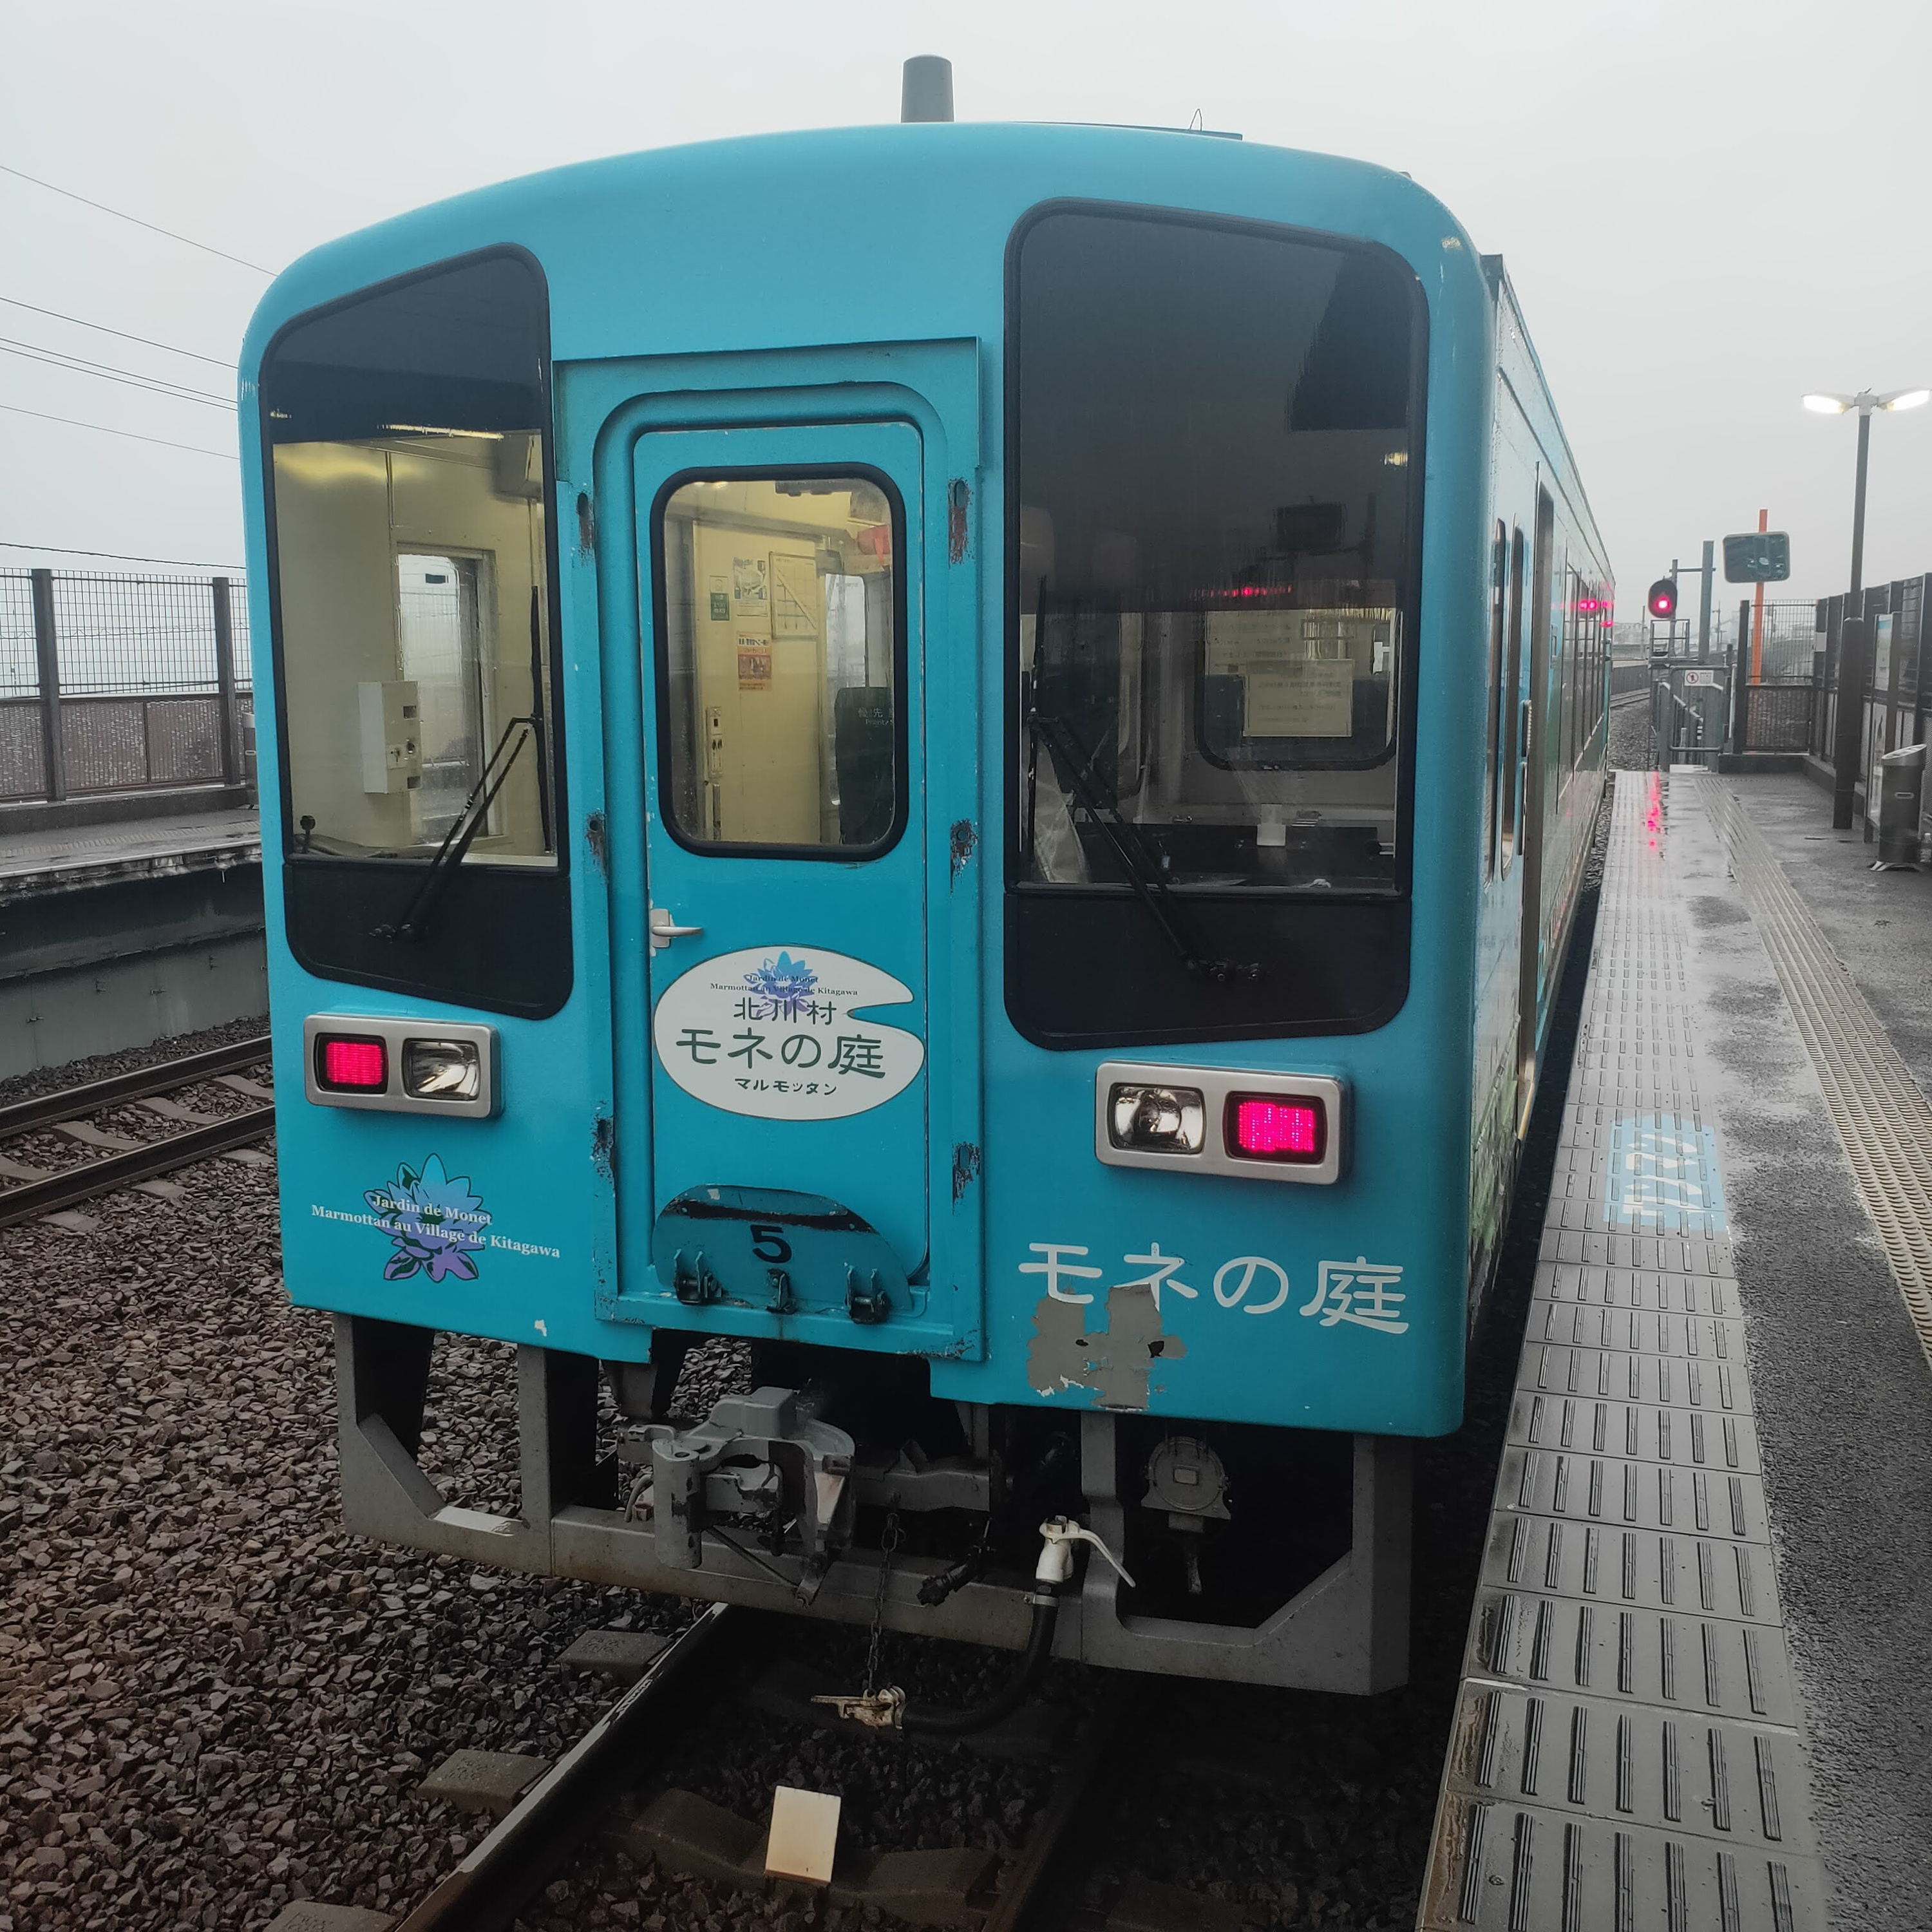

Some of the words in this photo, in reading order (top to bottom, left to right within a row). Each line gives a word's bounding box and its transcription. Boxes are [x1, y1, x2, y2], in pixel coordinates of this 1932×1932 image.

[817, 987, 858, 996] Kitagawa
[734, 997, 837, 1025] 北川村
[676, 1027, 886, 1079] モネの庭
[734, 1078, 837, 1095] マルモッタン
[373, 1196, 421, 1214] Jardin
[424, 1202, 442, 1217] de
[444, 1206, 493, 1226] Monet
[312, 1204, 390, 1229] Marmottan
[393, 1220, 412, 1233] au
[415, 1222, 465, 1242] Village
[468, 1230, 487, 1245] de
[490, 1235, 560, 1259] Kitagawa
[750, 1224, 792, 1264] 5
[1019, 1242, 1409, 1335] モネの庭
